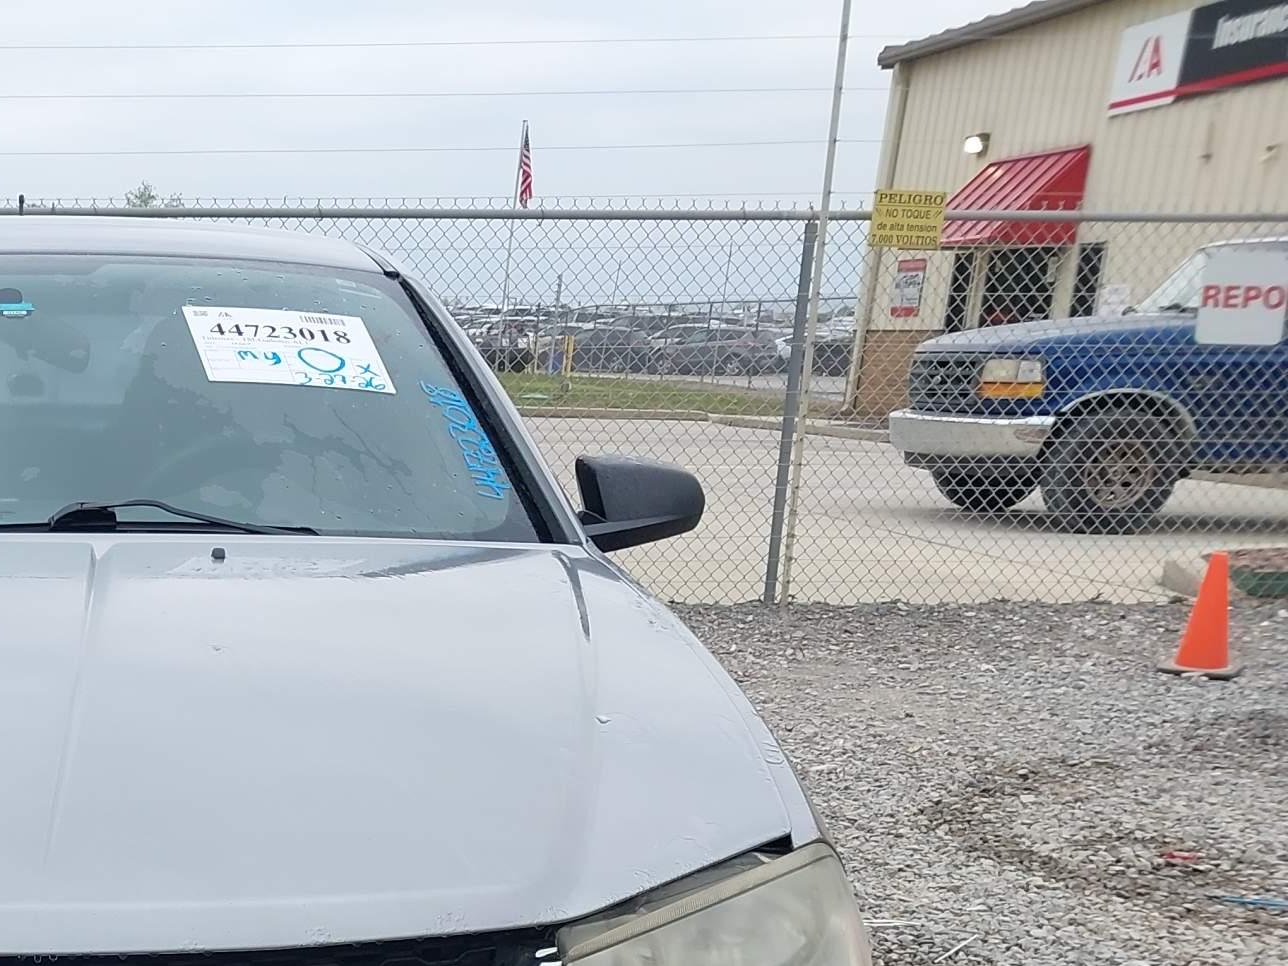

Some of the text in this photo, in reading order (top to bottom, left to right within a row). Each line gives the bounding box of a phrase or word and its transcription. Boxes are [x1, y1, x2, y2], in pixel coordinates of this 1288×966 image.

[879, 193, 944, 206] PELIGRO
[885, 209, 932, 220] NO TOQUE
[876, 221, 937, 233] de alta tension
[895, 235, 938, 247] VOLTIOS
[210, 322, 352, 345] 44723018
